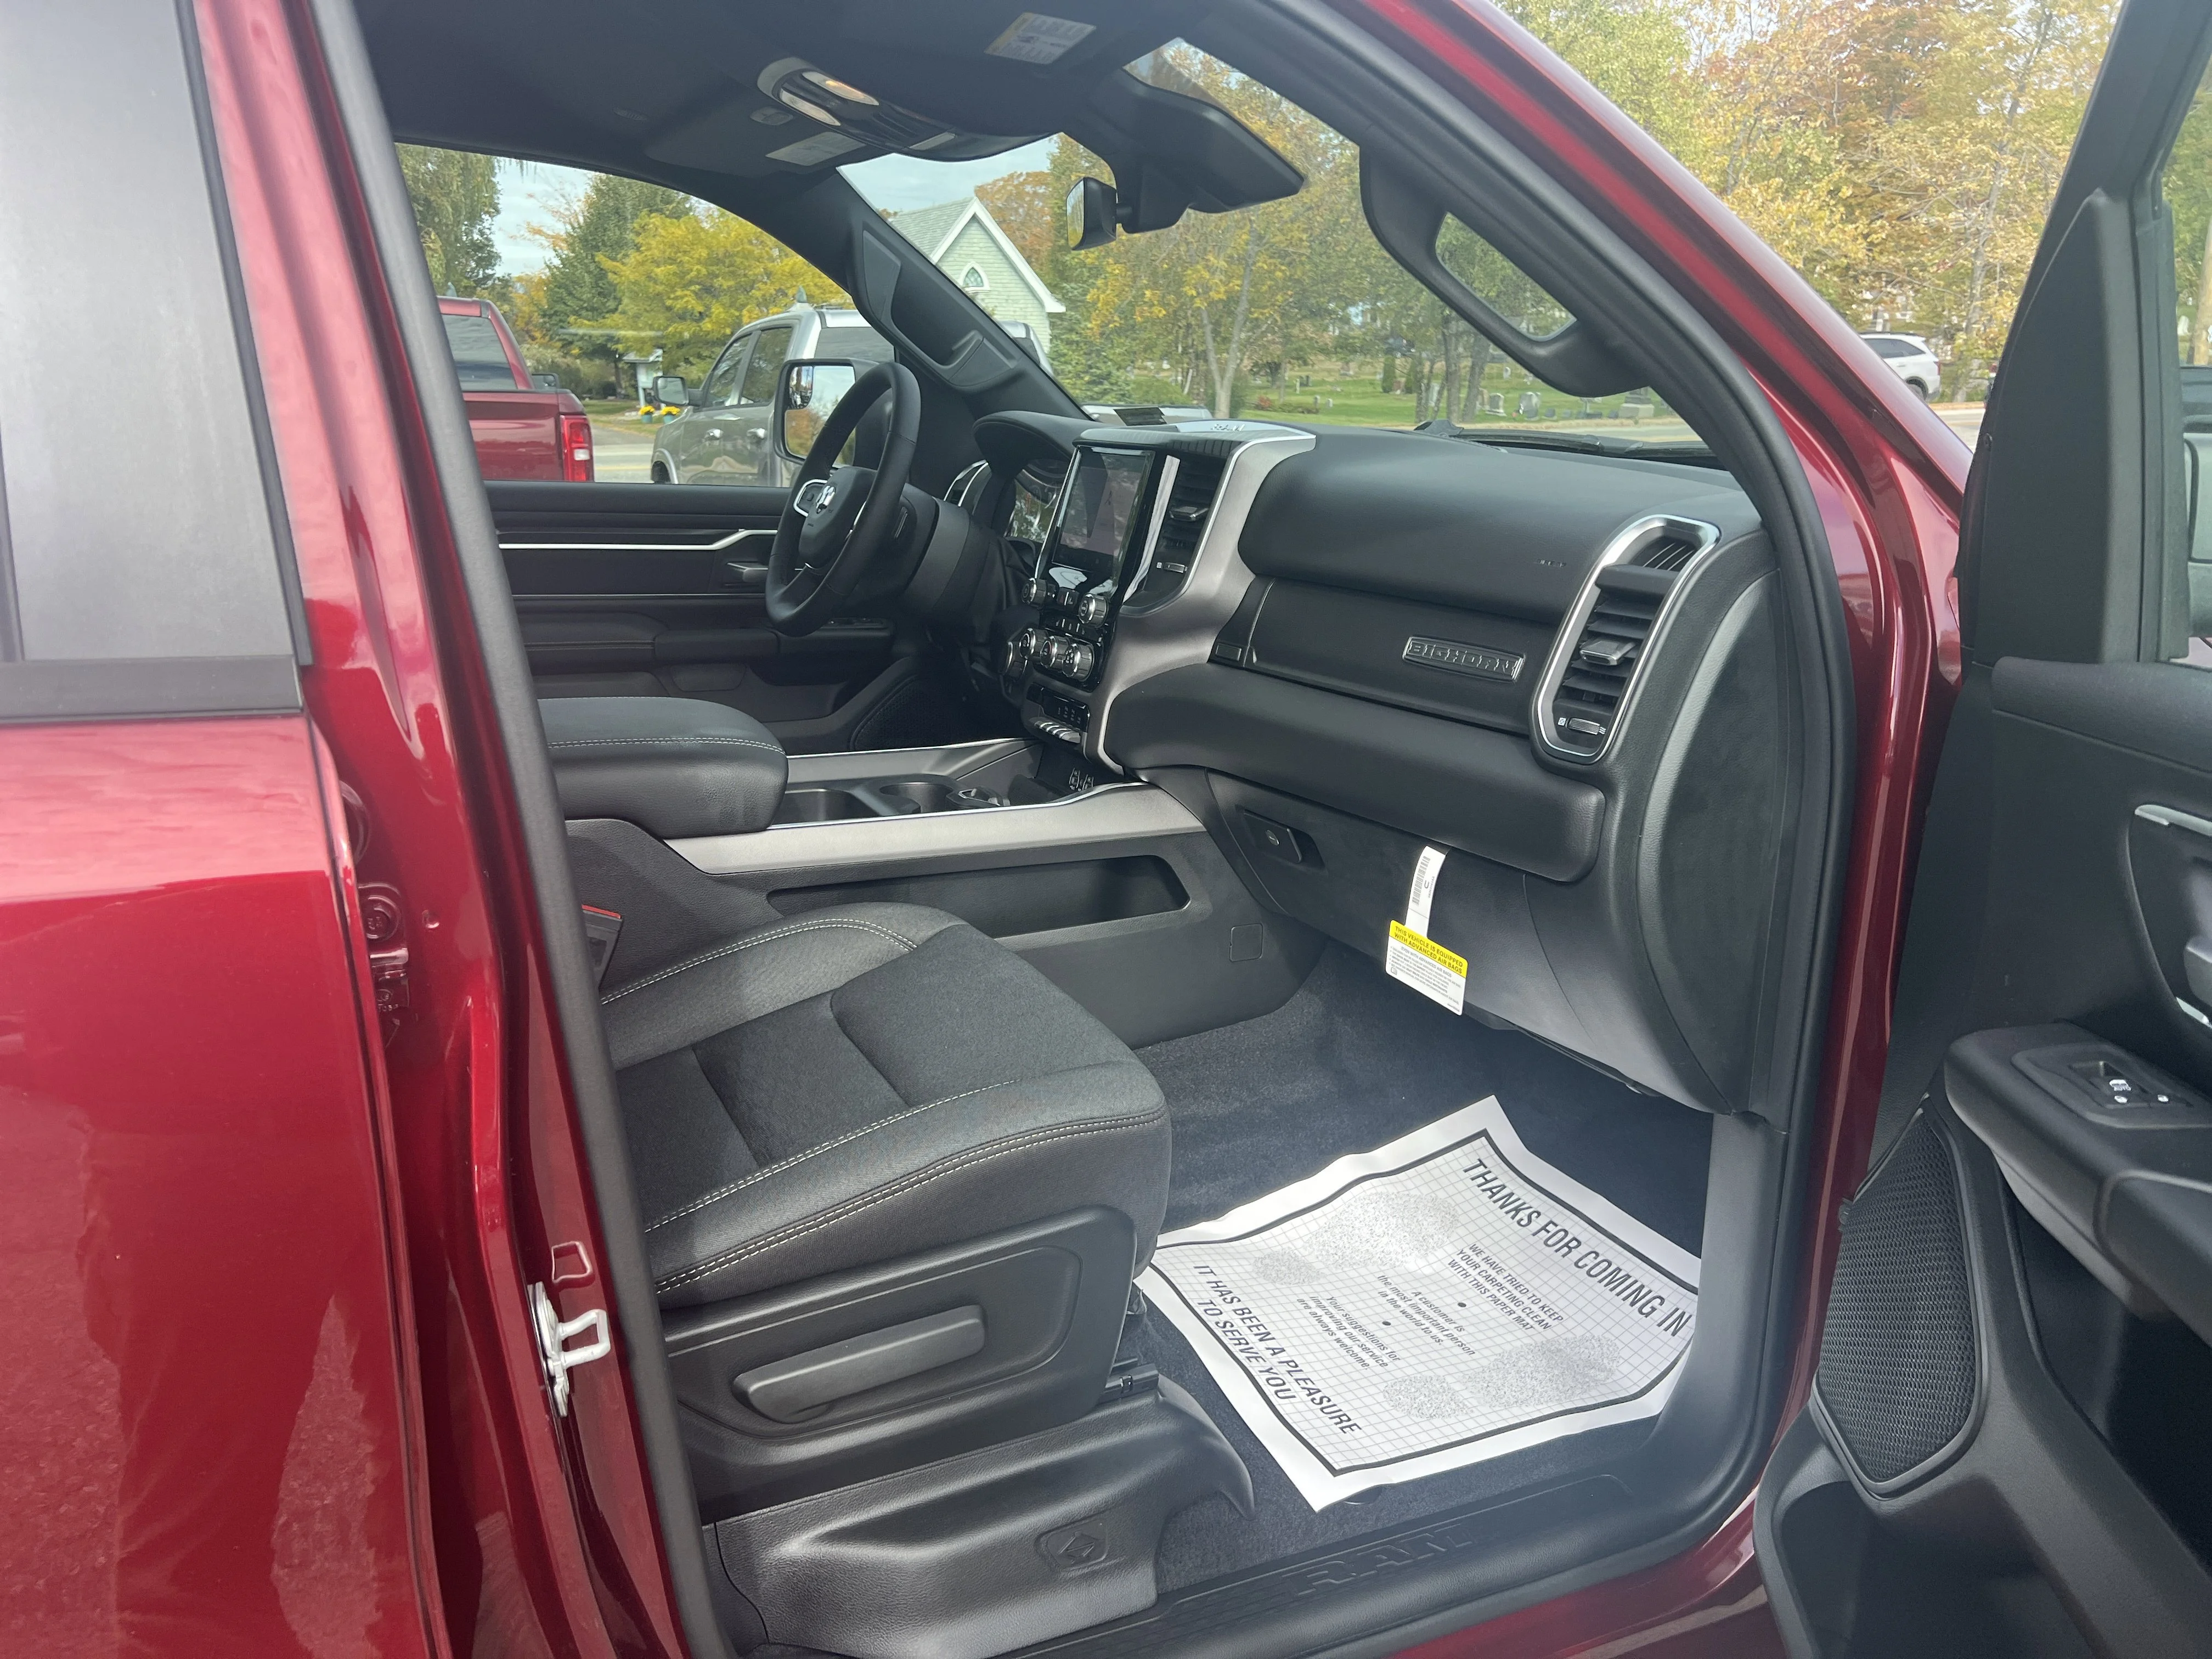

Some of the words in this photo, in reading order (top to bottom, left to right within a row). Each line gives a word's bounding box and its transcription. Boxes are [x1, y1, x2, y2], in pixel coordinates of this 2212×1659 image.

[1394, 932, 1408, 943] WITH
[1408, 940, 1437, 960] ADVANCED
[1437, 956, 1447, 966] AIR
[1448, 961, 1462, 974] BAGS
[1395, 926, 1407, 936] THIS
[1408, 933, 1429, 949] VEHICLE
[1436, 948, 1463, 967] EQUIPPED
[1463, 1158, 1541, 1227] THANKS
[1531, 1220, 1582, 1258] FOR
[1574, 1250, 1665, 1318] COMING
[1656, 1307, 1692, 1337] IN
[1469, 1244, 1485, 1257] WE
[1481, 1256, 1506, 1276] HAVE
[1503, 1273, 1529, 1295] TRIED
[1527, 1293, 1542, 1305] TO
[1538, 1304, 1563, 1322] KEEP
[1378, 1275, 1392, 1286] the
[1390, 1286, 1412, 1302] most
[1408, 1302, 1450, 1333] important
[1442, 1333, 1476, 1356] person
[1386, 1298, 1401, 1309] the
[1400, 1309, 1426, 1327] world
[1430, 1334, 1443, 1346] us.
[1418, 1297, 1457, 1325] customer
[1454, 1325, 1465, 1333] is
[1448, 1259, 1471, 1279] WITH
[1468, 1277, 1490, 1295] THIS
[1486, 1294, 1516, 1316] PAPER
[1512, 1316, 1535, 1330] MAT
[1457, 1249, 1481, 1271] YOUR
[1478, 1269, 1524, 1307] CARPETING
[1521, 1307, 1552, 1330] CLEAN
[1193, 1265, 1217, 1276] IT
[1206, 1280, 1242, 1305] HAS
[1232, 1307, 1276, 1342] BEEN
[1265, 1347, 1286, 1356] A
[1278, 1359, 1362, 1435] PLEASURE
[1197, 1299, 1223, 1316] TO
[1215, 1321, 1267, 1363] SERVE
[1258, 1367, 1297, 1400] YOU
[1296, 1299, 1312, 1310] are
[1309, 1311, 1336, 1337] always
[1334, 1338, 1370, 1370] welcome.
[1310, 1296, 1347, 1331] improving
[1344, 1331, 1361, 1343] our
[1357, 1343, 1389, 1368] service
[1327, 1296, 1346, 1312] Your
[1342, 1313, 1388, 1352] suggestions
[1385, 1351, 1401, 1361] for
